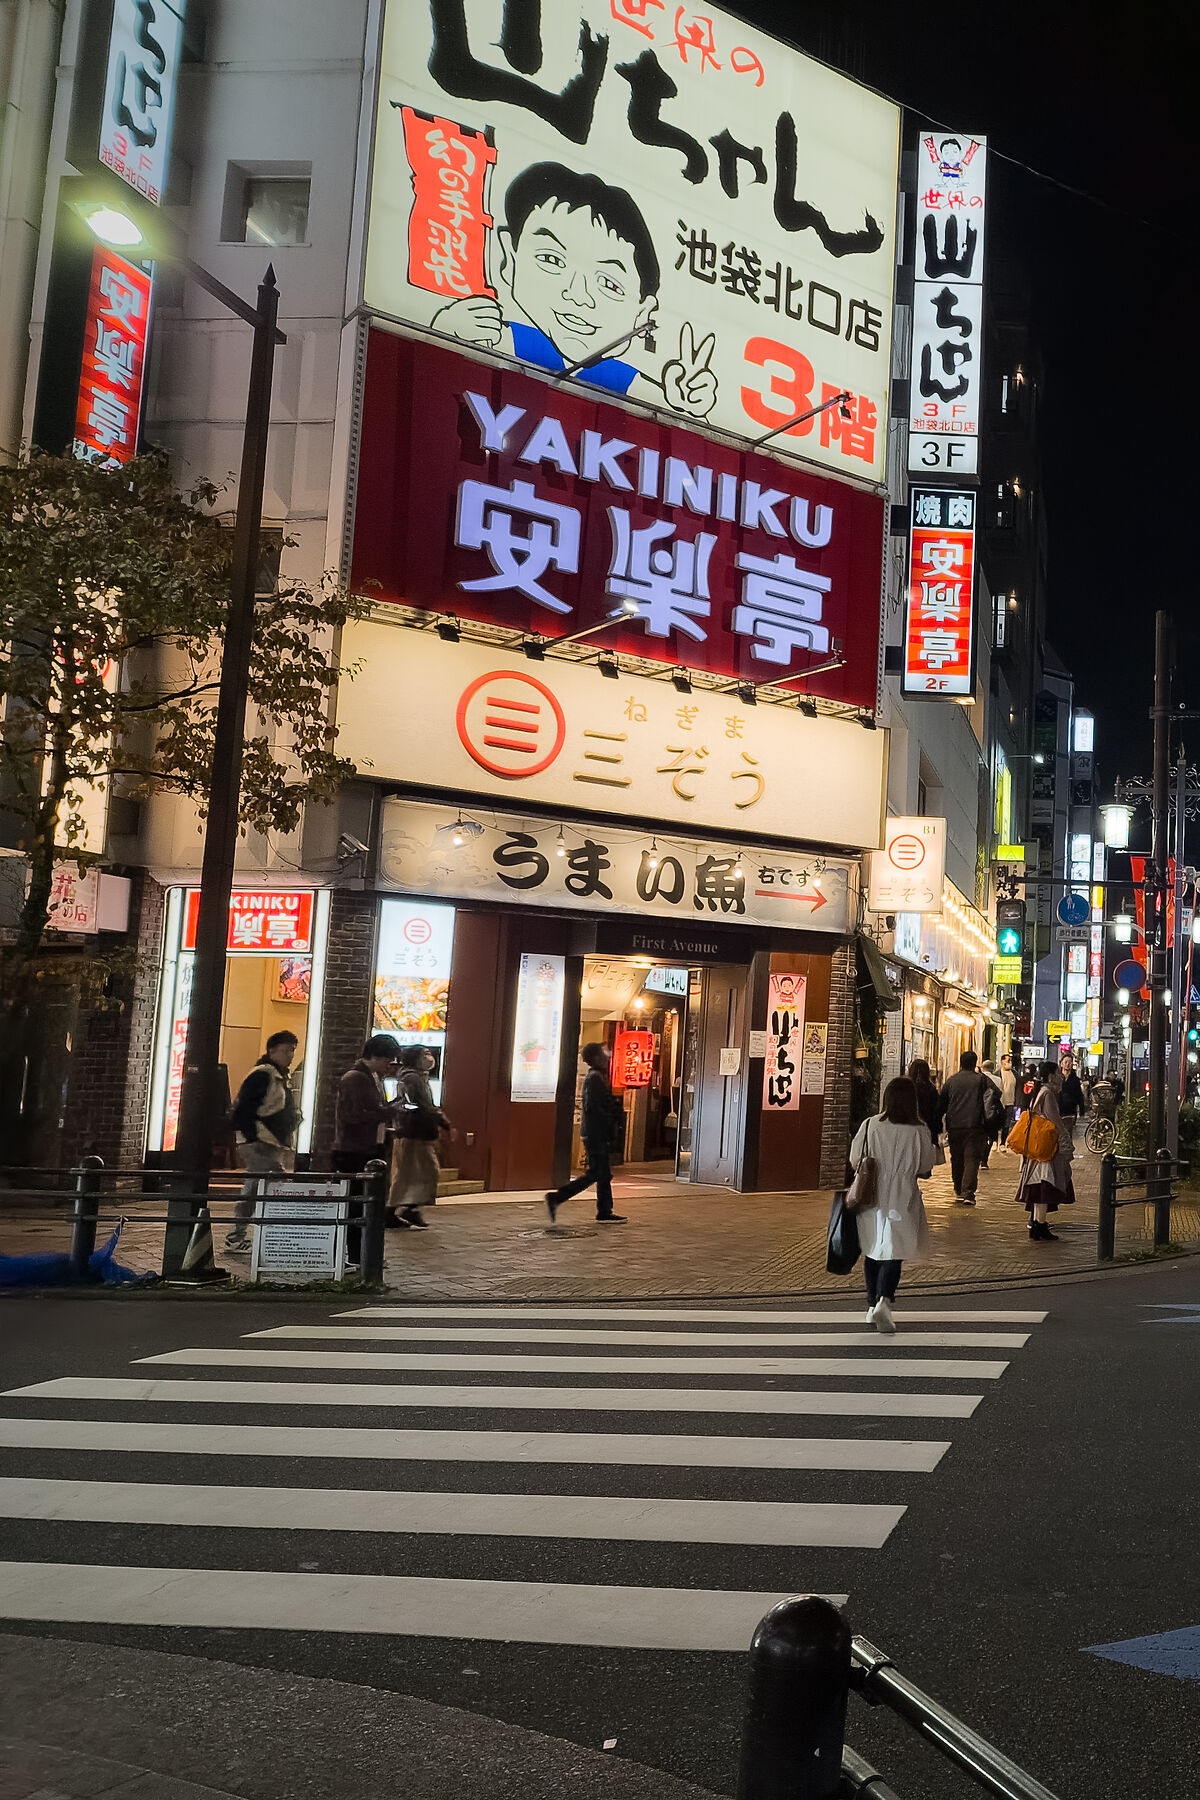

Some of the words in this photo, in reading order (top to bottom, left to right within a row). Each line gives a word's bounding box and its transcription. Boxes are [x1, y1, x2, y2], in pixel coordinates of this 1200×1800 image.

[610, 0, 766, 87] 世界の
[427, 0, 885, 259] 山ちゃん
[102, 144, 160, 204] 池袋北口店
[921, 188, 984, 210] 世界の
[675, 218, 884, 353] 池袋北口店
[919, 214, 978, 403] 山ちゃん
[88, 265, 142, 448] 安楽亭
[739, 335, 877, 465] 3階
[912, 418, 976, 433] 池袋北口店
[463, 389, 834, 548] YAKINIKU
[921, 441, 966, 468] 3F
[915, 493, 973, 527] 焼肉
[454, 477, 834, 666] 安楽亭
[919, 539, 964, 670] 安楽亭
[924, 677, 950, 690] 2F
[623, 694, 746, 740] ねぎま
[571, 728, 767, 810] 三ぞう
[922, 825, 937, 835] B1
[492, 831, 747, 916] うまい魚
[757, 865, 811, 888] 右です
[877, 887, 935, 904] 三ぞう
[229, 895, 299, 910] KINIKU
[232, 912, 298, 945] 楽亭
[631, 934, 666, 950] First
[672, 937, 719, 953] Avenue
[392, 953, 438, 968] 三ぞう
[766, 1034, 779, 1077] 幻の手羽先
[768, 1009, 799, 1107] 山ちゃん
